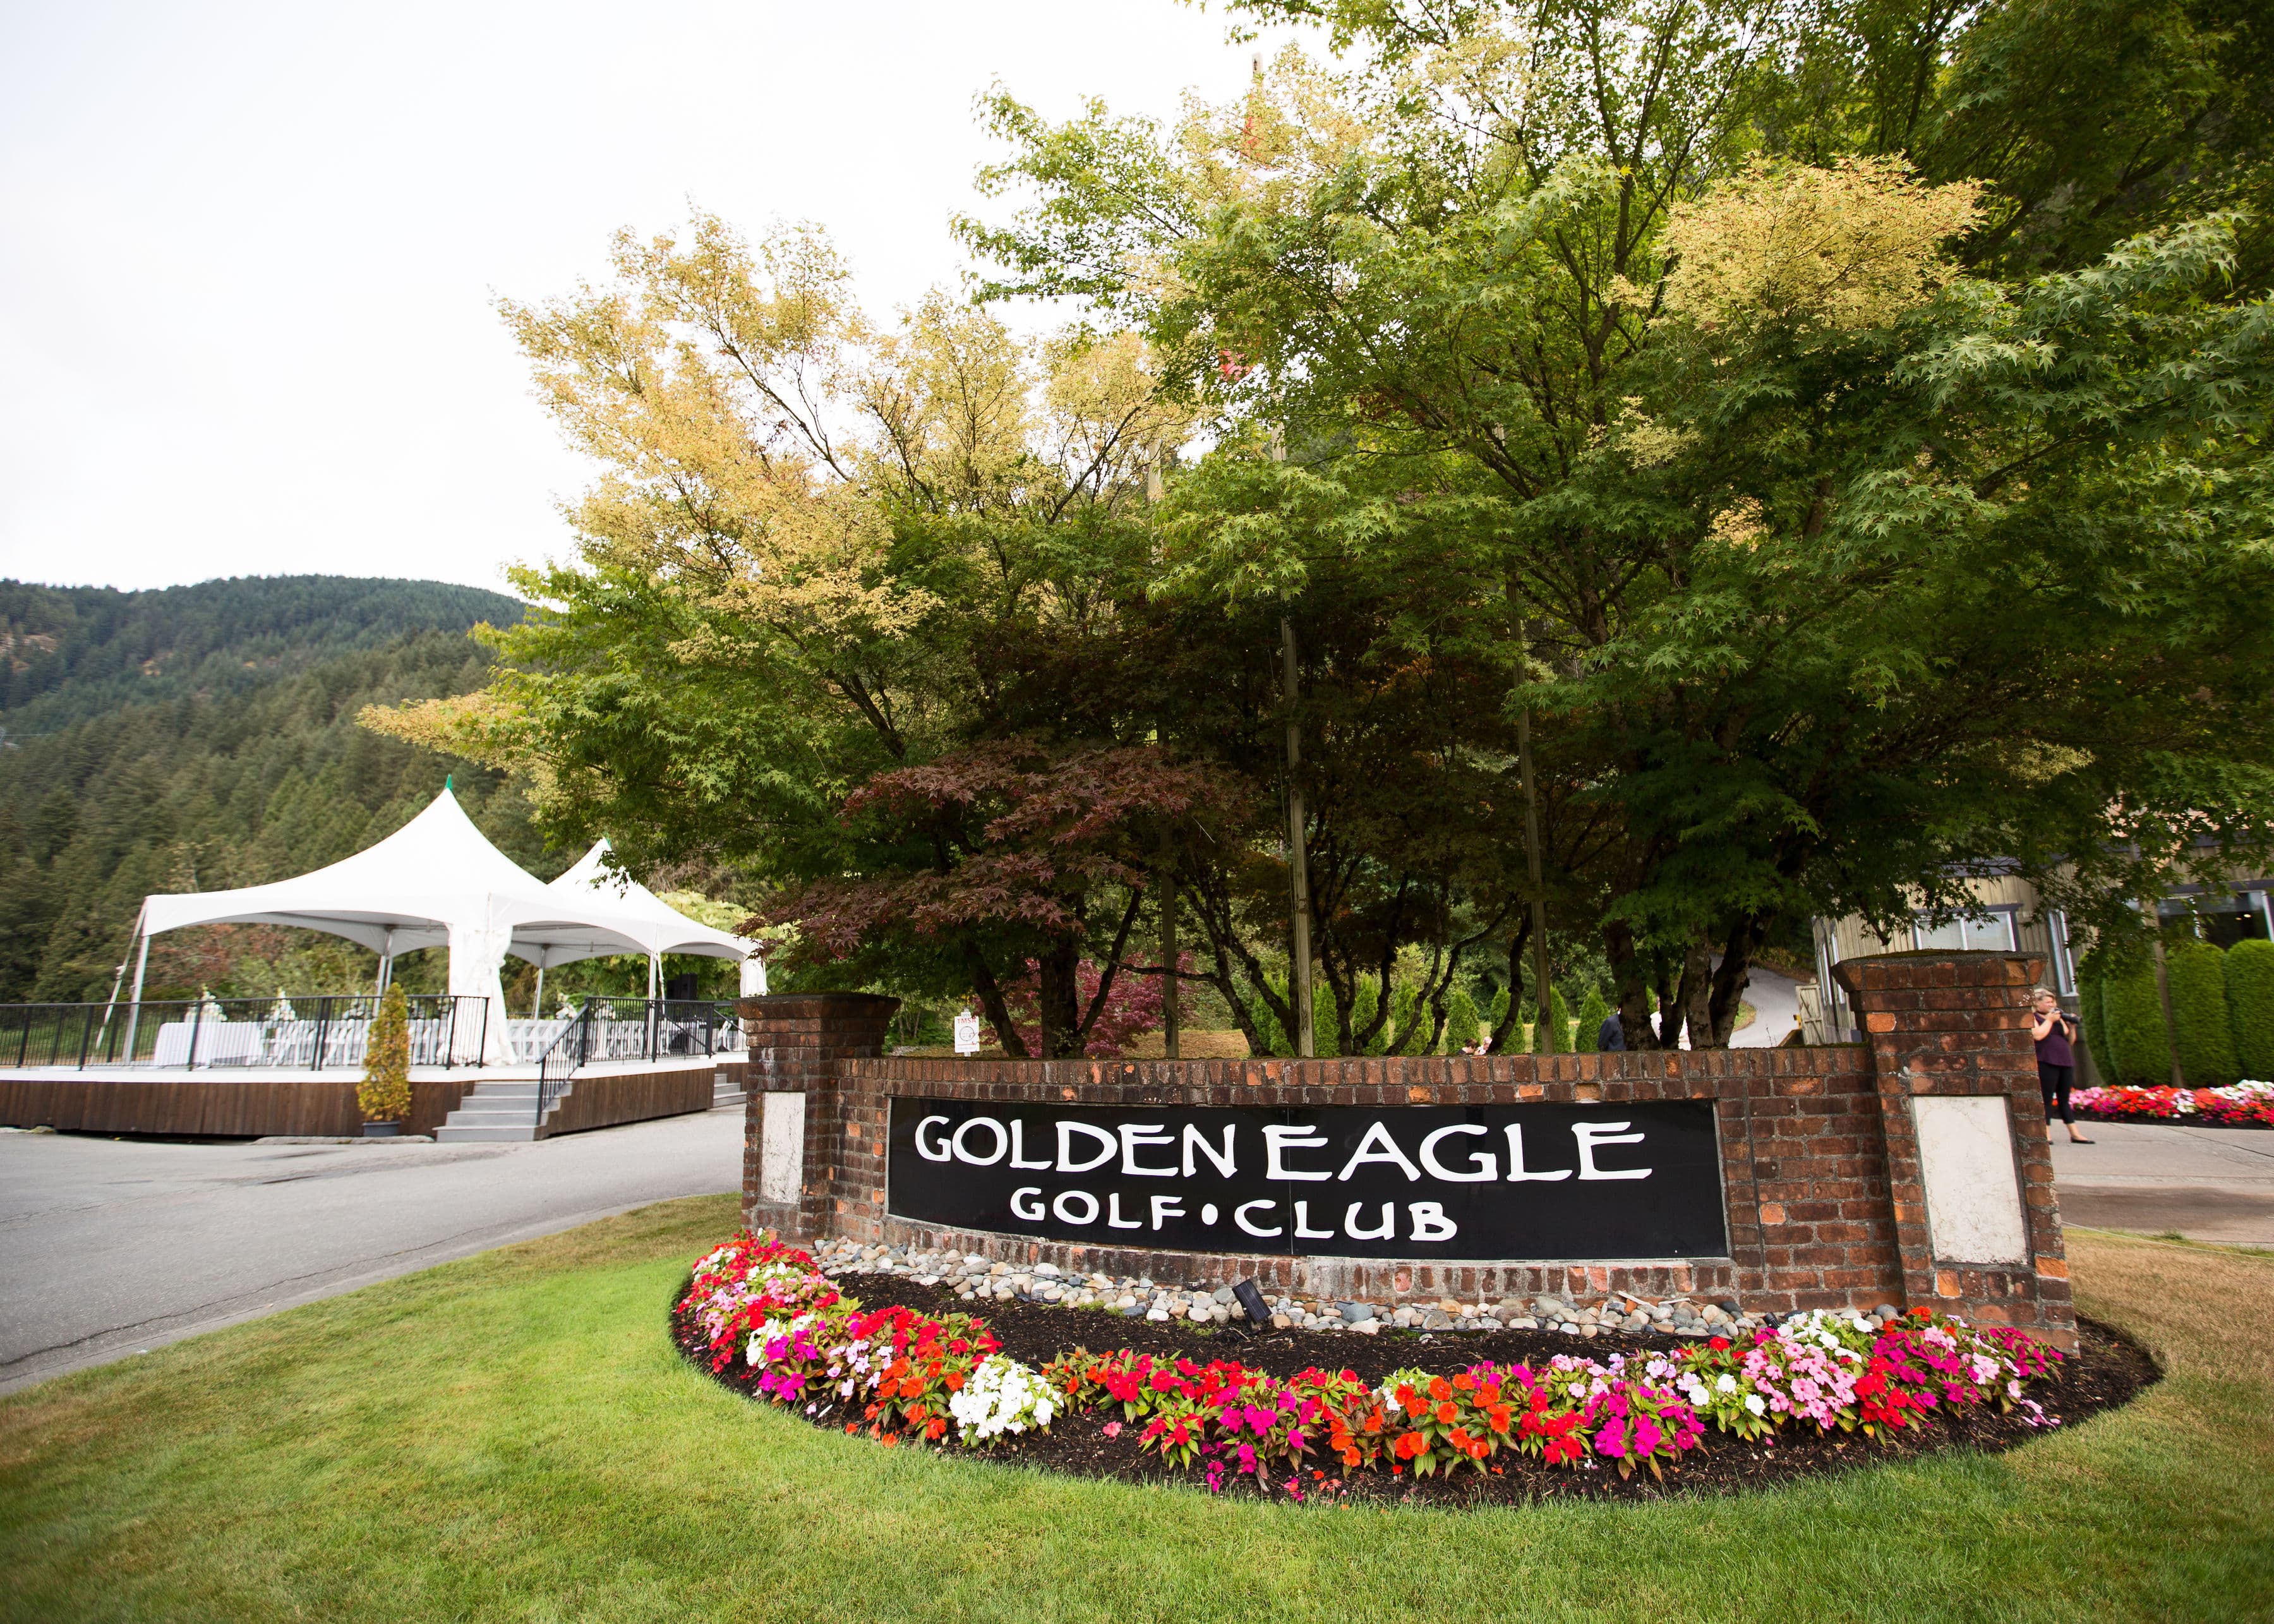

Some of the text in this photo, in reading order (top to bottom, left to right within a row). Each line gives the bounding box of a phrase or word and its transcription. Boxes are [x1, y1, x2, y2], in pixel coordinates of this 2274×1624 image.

[915, 1116, 1652, 1182] GOLDEN EAGLE
[1010, 1187, 1458, 1241] GOLF CLUB
